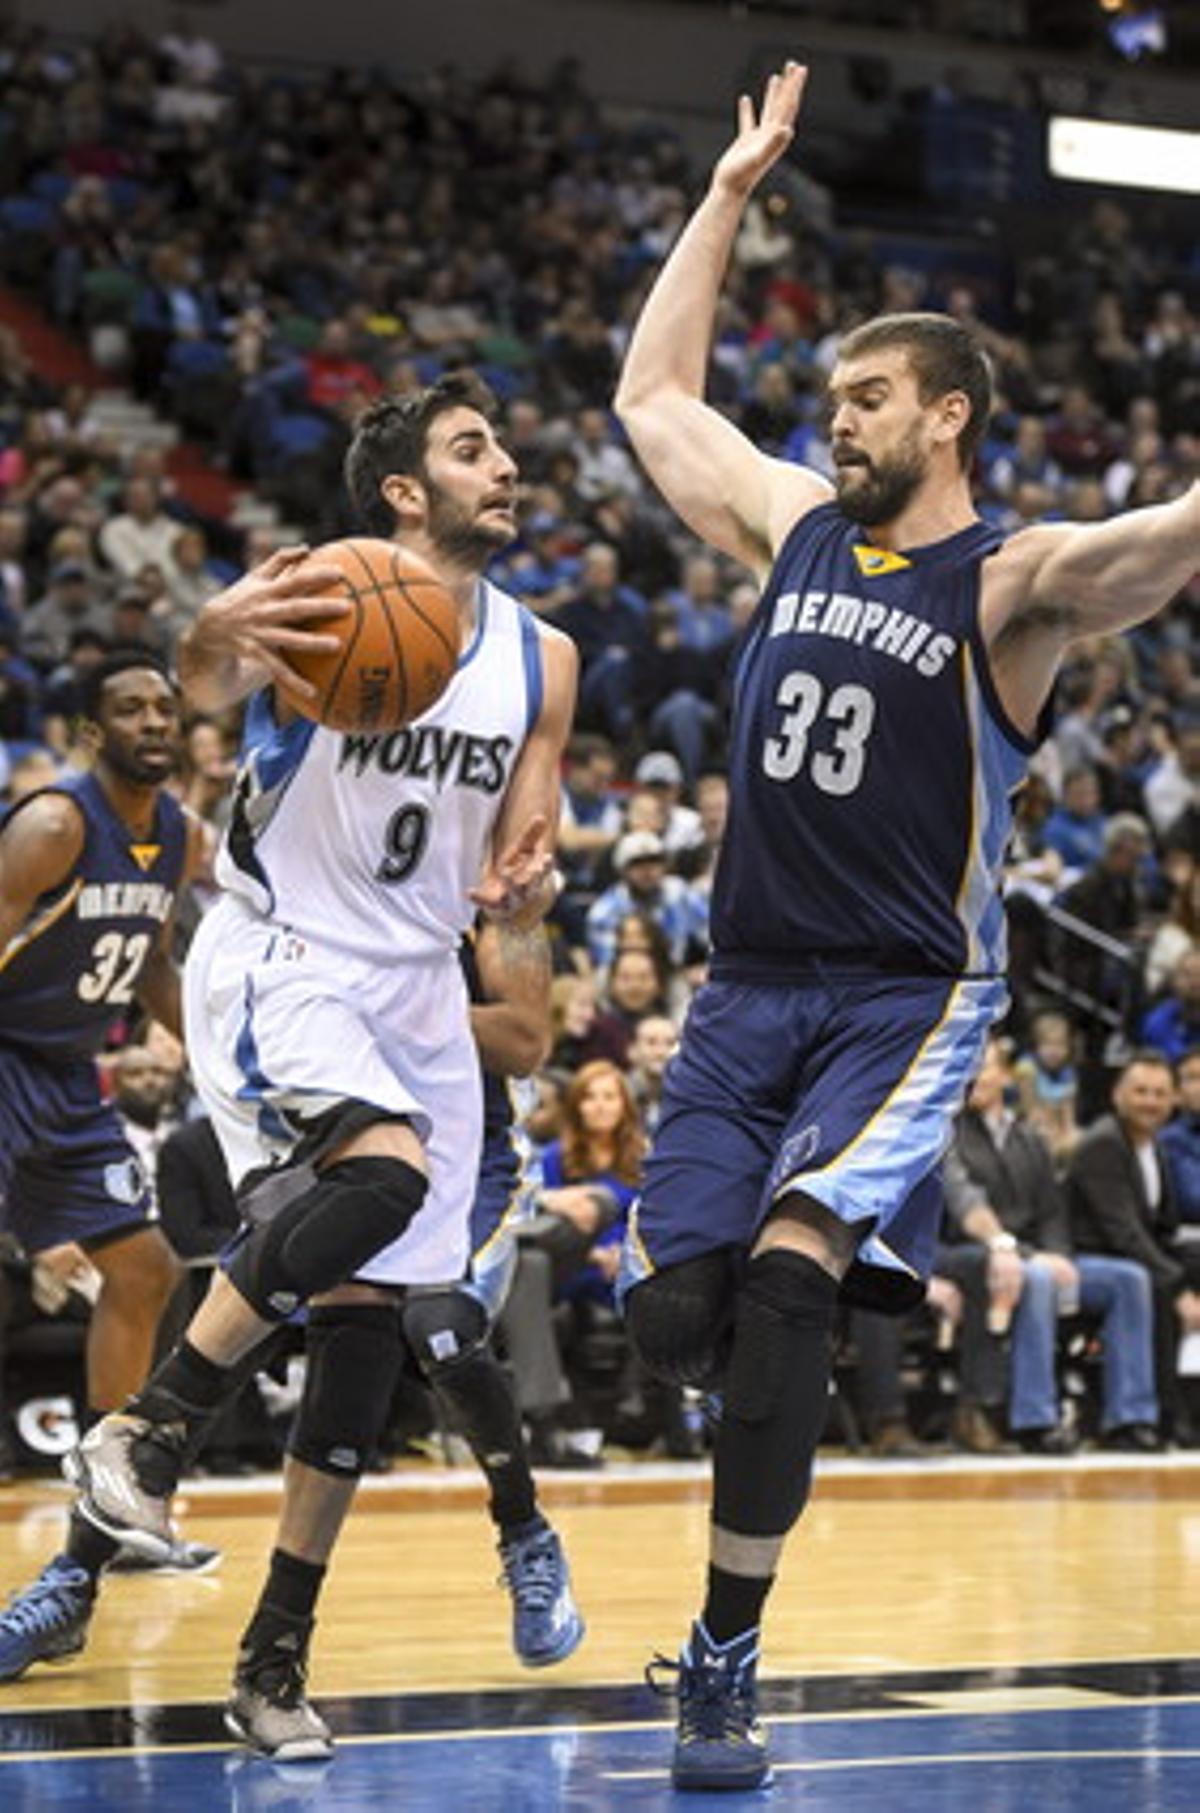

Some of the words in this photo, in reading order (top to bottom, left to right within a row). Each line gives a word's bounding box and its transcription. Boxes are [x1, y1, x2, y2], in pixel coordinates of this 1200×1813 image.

[336, 727, 513, 795] WOLVES
[762, 670, 876, 796] 33
[375, 802, 433, 885] 9
[77, 931, 150, 1004] 32
[17, 1397, 80, 1455] G
